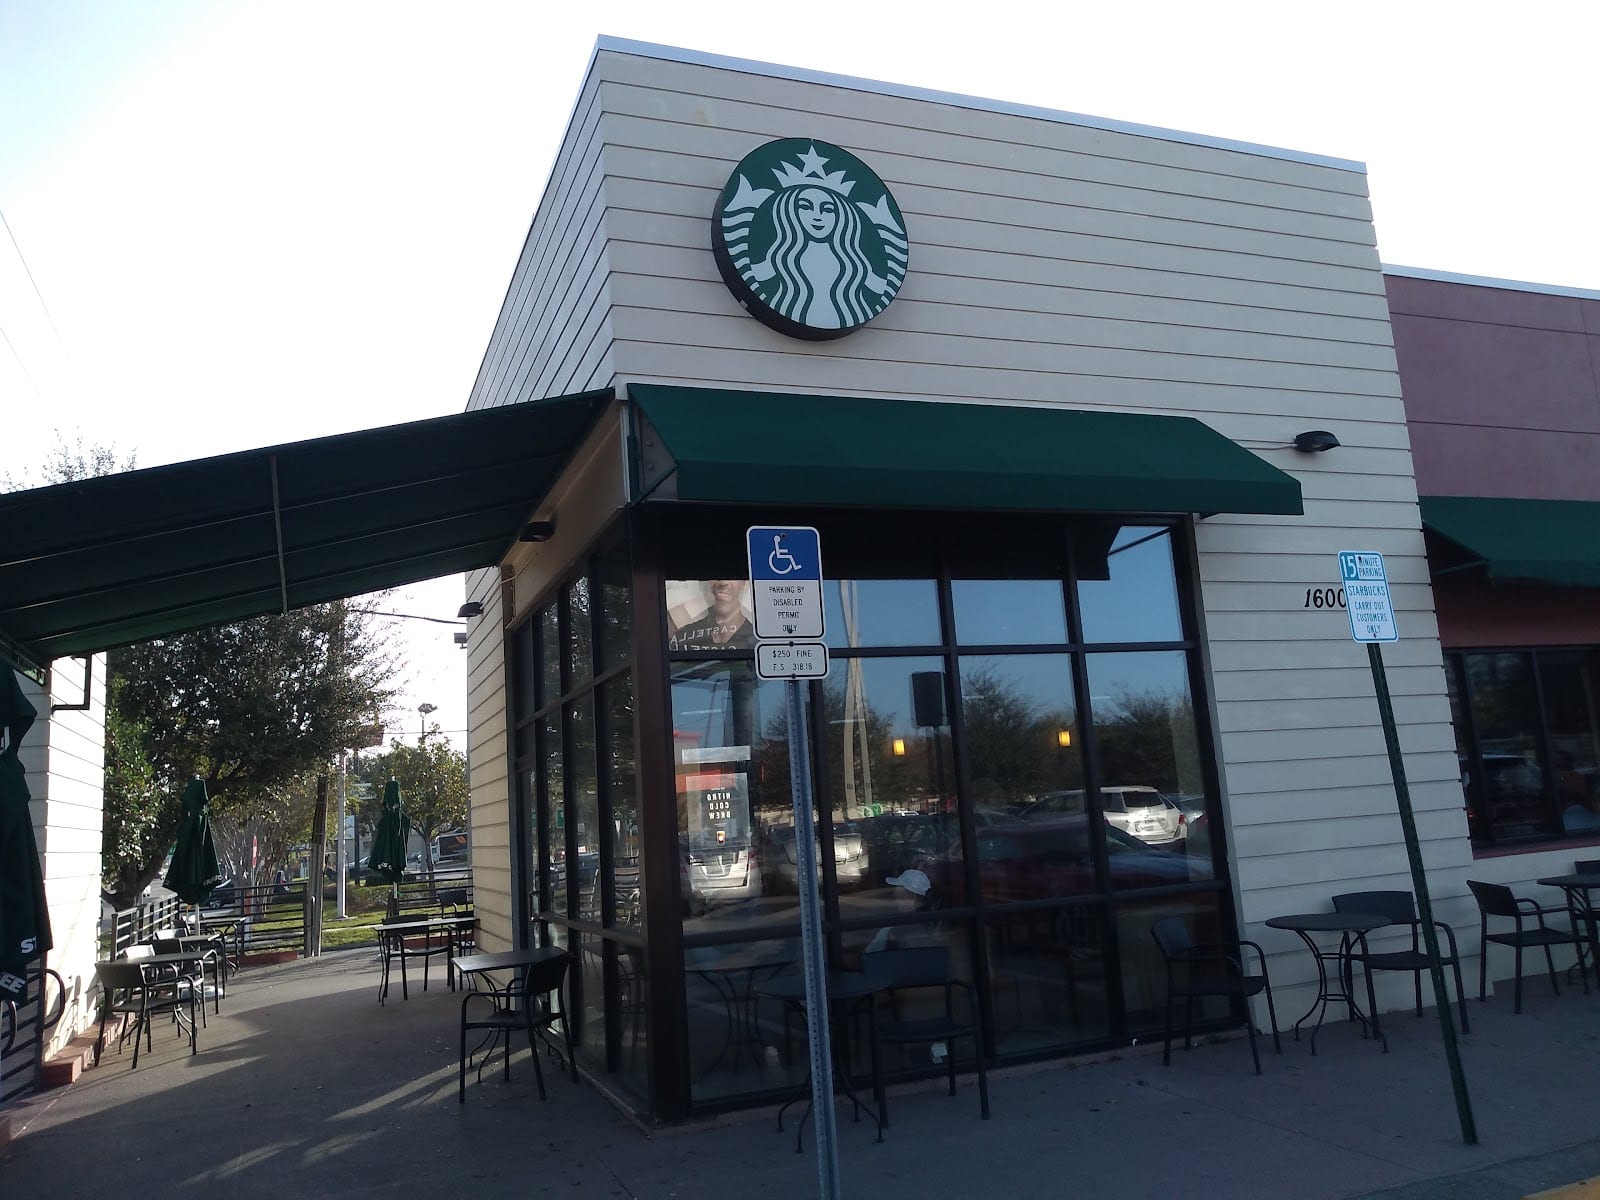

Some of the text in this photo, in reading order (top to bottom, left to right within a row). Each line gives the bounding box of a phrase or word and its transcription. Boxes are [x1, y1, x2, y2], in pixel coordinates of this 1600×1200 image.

[1341, 555, 1356, 578] 15
[1359, 567, 1382, 577] PARKING
[1348, 585, 1386, 596] STARBUCKS
[1355, 601, 1385, 610] CARRY OUT
[778, 611, 800, 619] PERMIT
[1356, 613, 1388, 622] CUSTOMERS
[782, 624, 798, 632] ONLY
[1366, 624, 1381, 634] ONLY
[772, 650, 812, 658] $250 FINE
